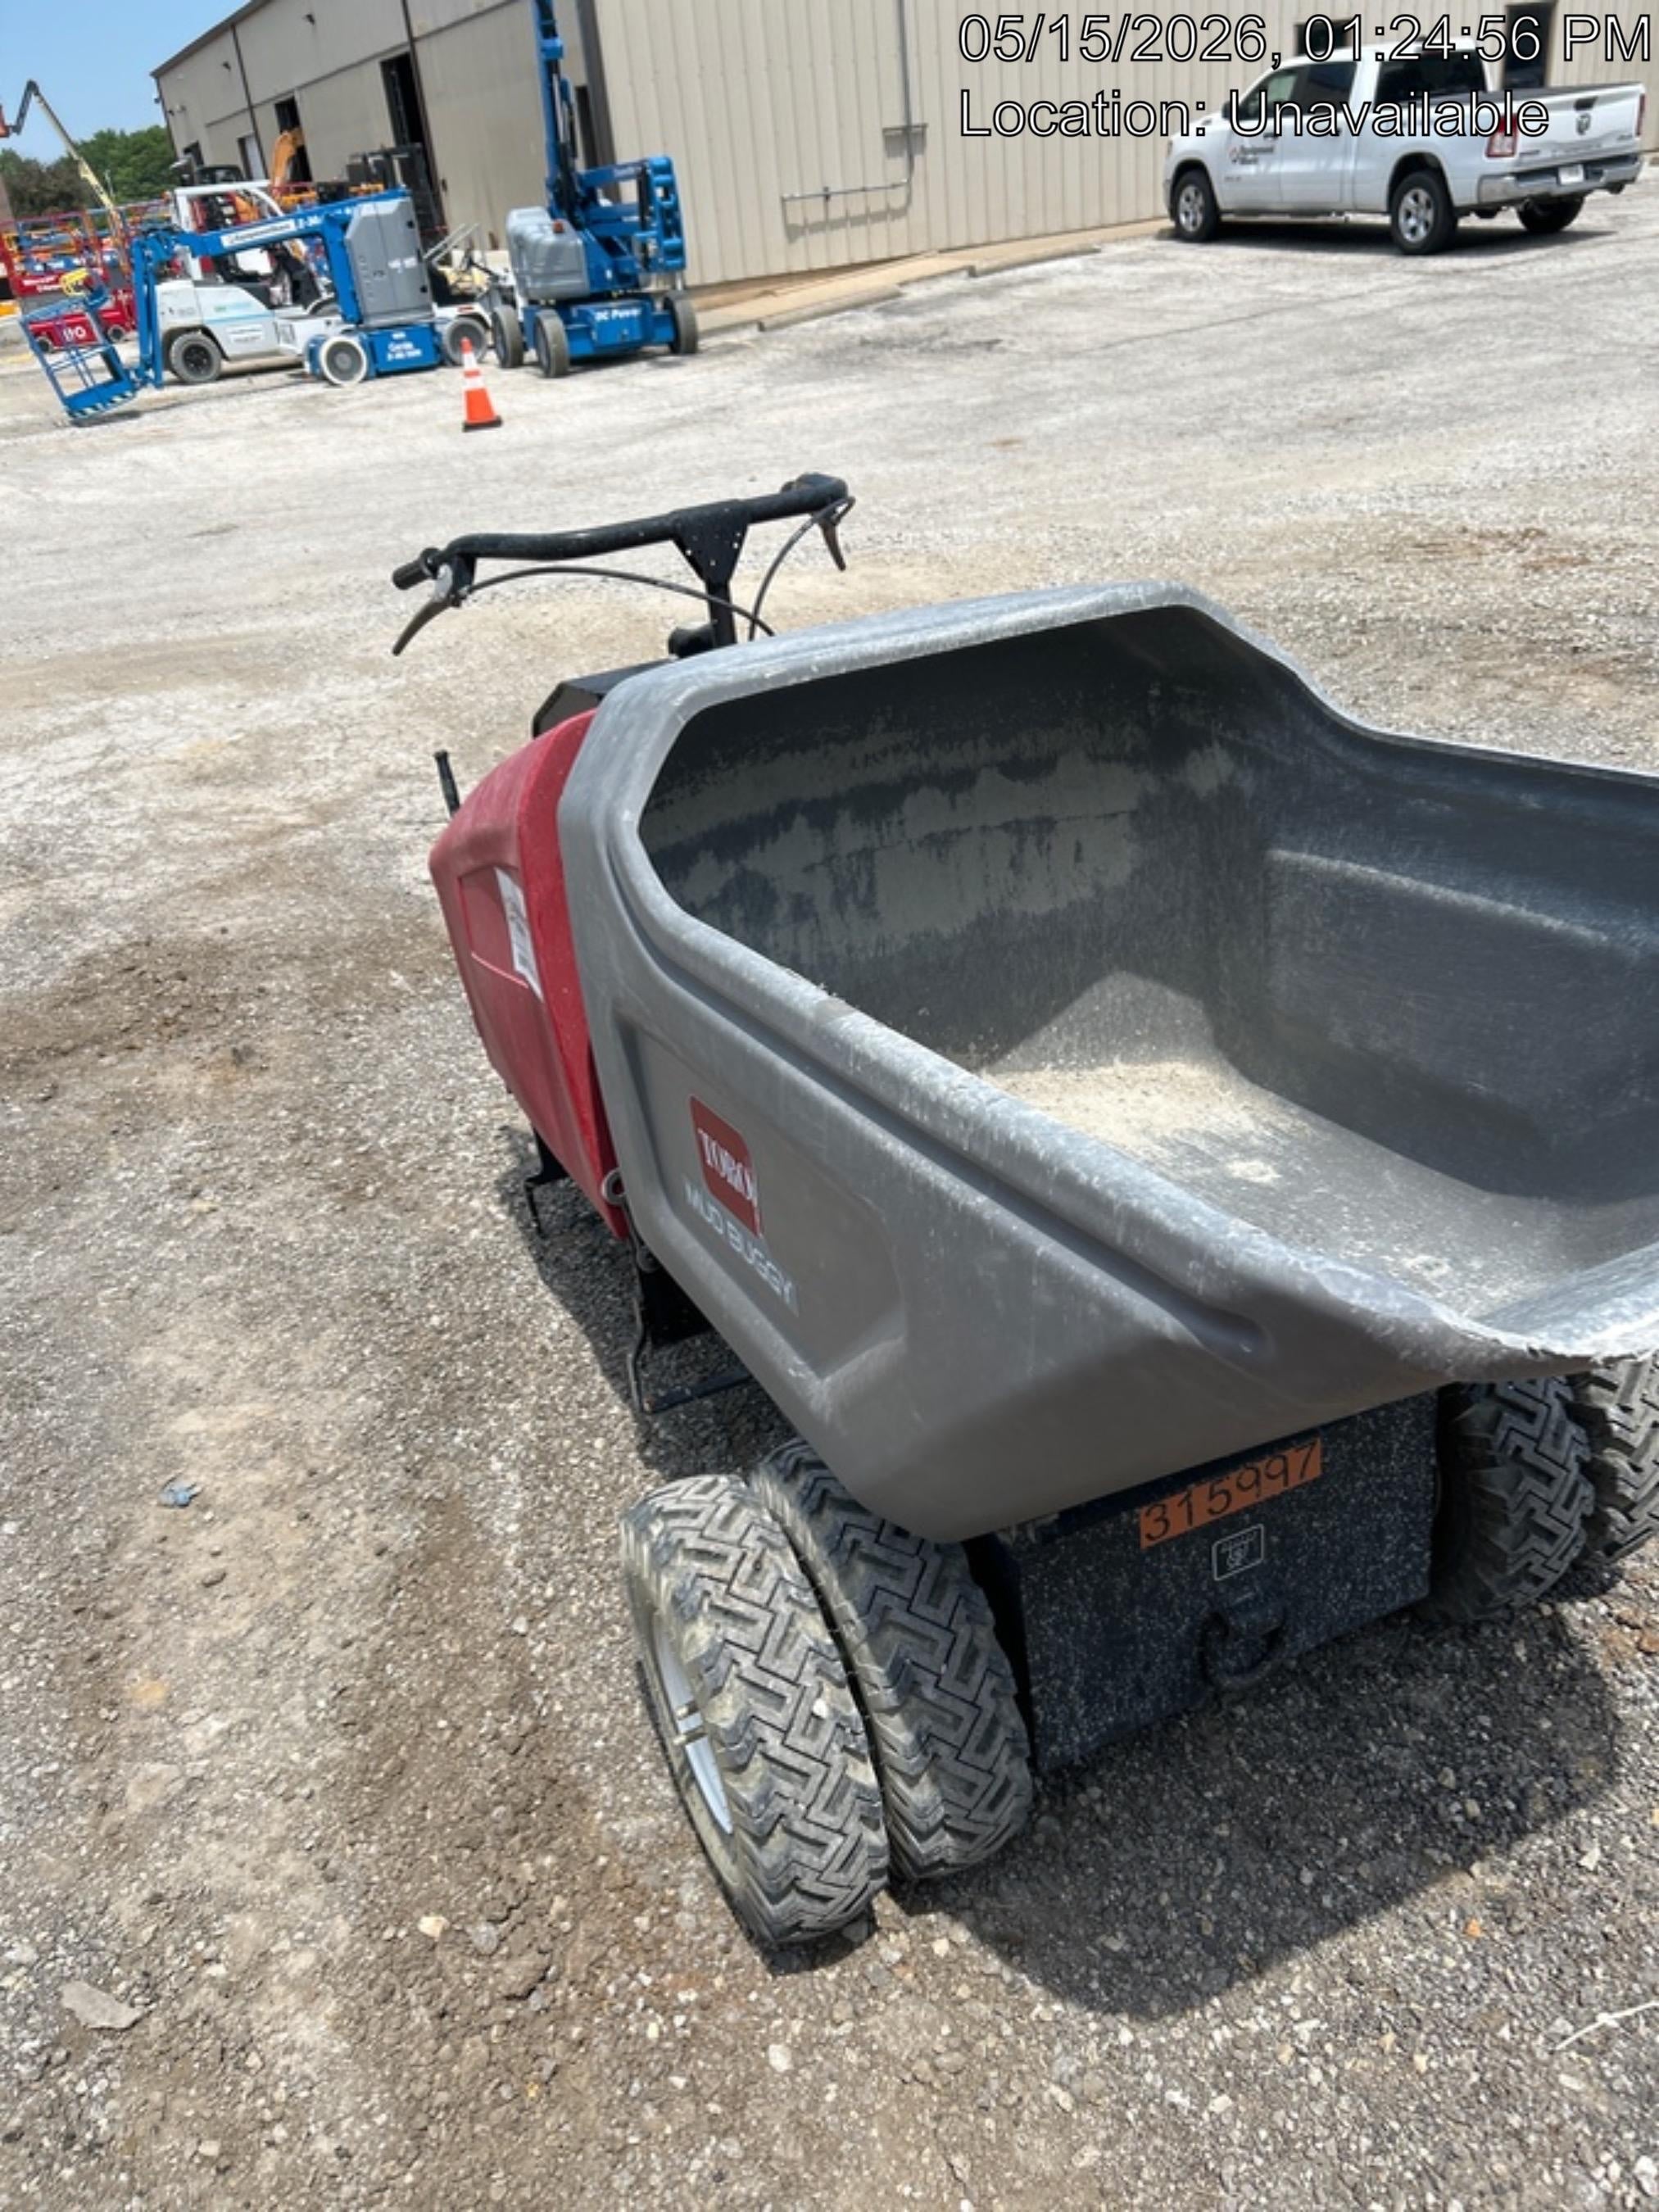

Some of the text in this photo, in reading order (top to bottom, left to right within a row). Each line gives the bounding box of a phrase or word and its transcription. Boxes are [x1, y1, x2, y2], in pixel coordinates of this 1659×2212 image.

[683, 1178, 794, 1306] MUD BUGGY
[1144, 1439, 1320, 1541] 315997
